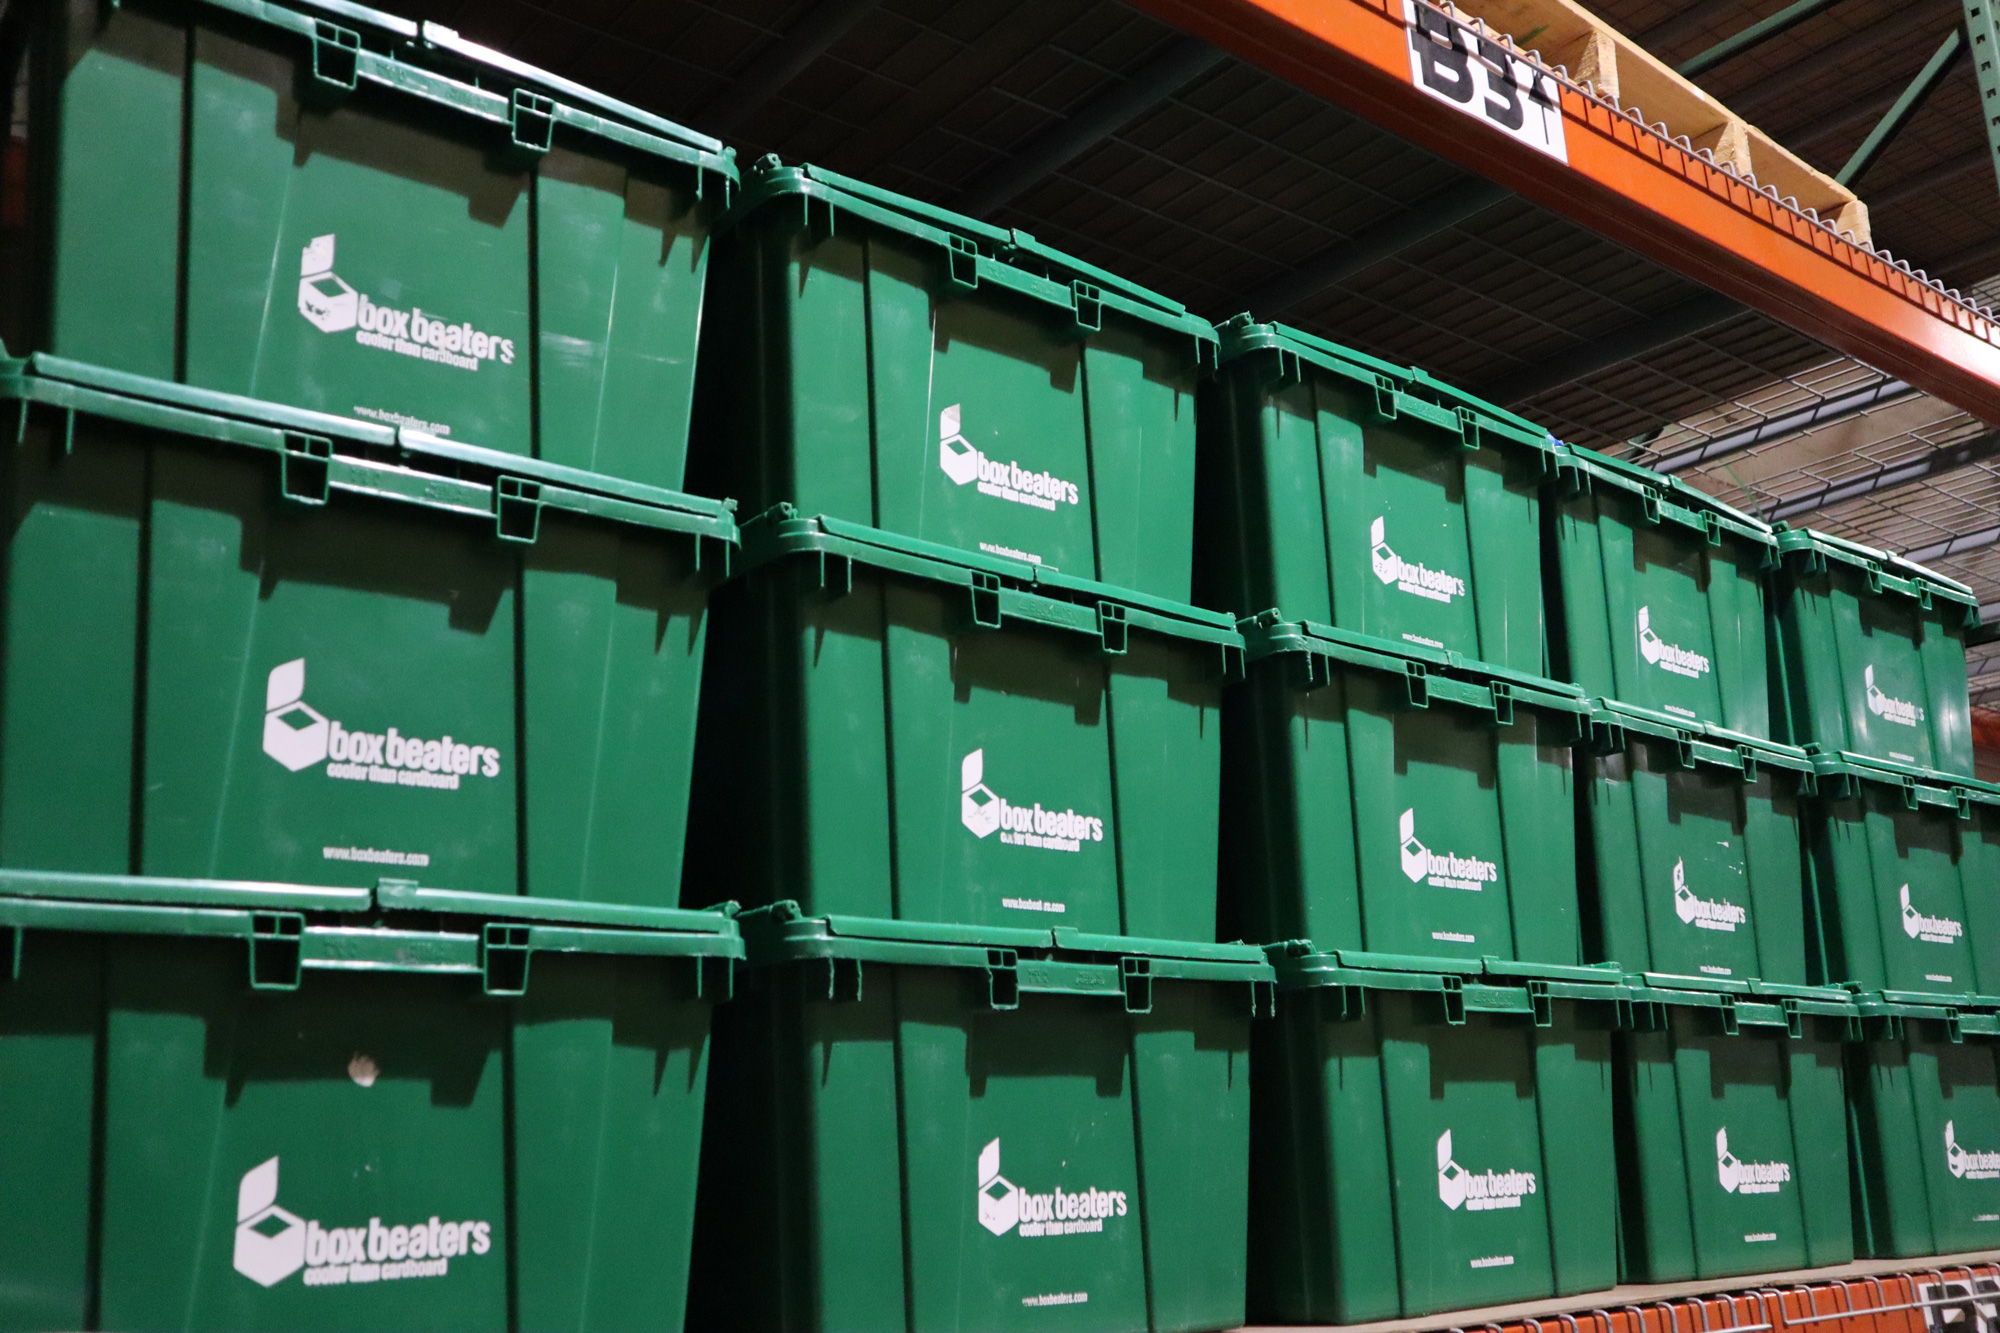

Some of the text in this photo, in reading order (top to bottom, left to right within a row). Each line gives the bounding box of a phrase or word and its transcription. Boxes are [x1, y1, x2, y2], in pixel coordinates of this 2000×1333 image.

[355, 330, 395, 351] cooler
[395, 337, 422, 358] than
[357, 293, 515, 365] box beaters
[977, 450, 1079, 505] box beaters
[1397, 555, 1420, 585] box
[1419, 562, 1466, 597] beaters
[1658, 638, 1676, 664] box
[1674, 643, 1710, 674] beaters
[328, 720, 500, 778] box beaters
[326, 762, 460, 790] cooler than cardboard
[1000, 798, 1104, 842] box beaters
[322, 846, 430, 867] www.boxbeaters.com
[1427, 848, 1498, 883] box beaters
[1002, 897, 1066, 913] www.boxbeatrs.com
[1693, 895, 1746, 924] box beaters
[1464, 1168, 1537, 1199] box beaters
[1737, 1159, 1791, 1184] box beaters
[1019, 1186, 1128, 1223] box beaters
[305, 1215, 491, 1267] box beaters
[1064, 1218, 1103, 1235] cardboard
[303, 1264, 349, 1286] cooler
[380, 1257, 448, 1281] cardboard
